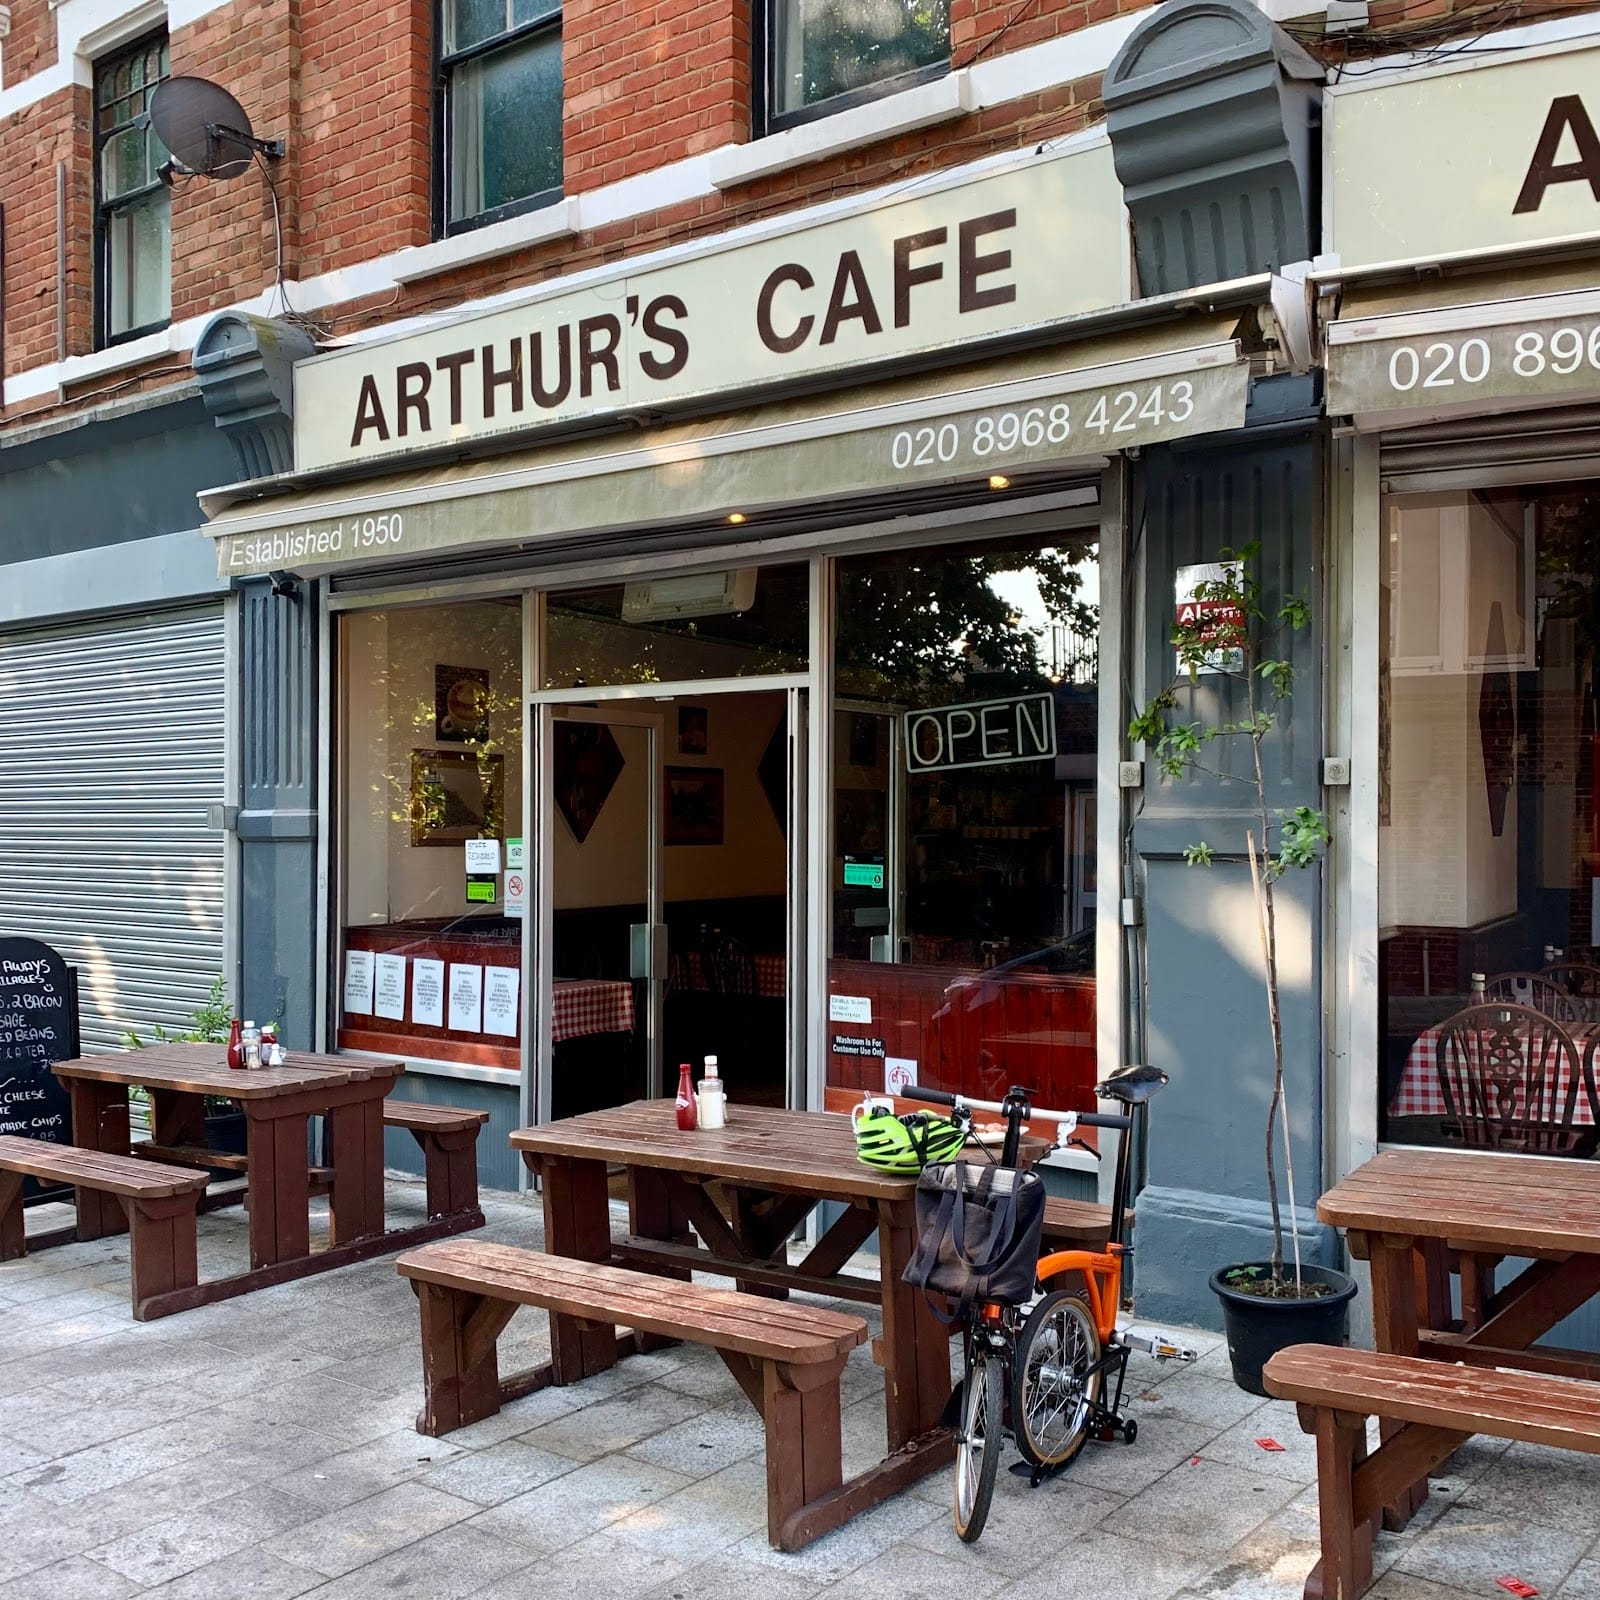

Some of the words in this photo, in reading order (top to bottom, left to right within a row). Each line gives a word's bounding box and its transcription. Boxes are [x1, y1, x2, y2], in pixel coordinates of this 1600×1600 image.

[1512, 94, 1600, 215] A
[350, 294, 690, 448] ARTHUR'S
[757, 208, 1017, 354] CAFE
[1388, 338, 1491, 391] 020
[891, 423, 960, 469] 020
[972, 403, 1070, 456] 8968
[1084, 380, 1195, 435] 4243
[229, 522, 343, 566] Established
[351, 513, 403, 548] 1950
[911, 700, 1049, 765] OPEN
[2, 959, 51, 975] AWAYS
[23, 994, 63, 1009] BACON
[832, 1044, 859, 1055] Customer
[860, 1046, 871, 1056] Use
[872, 1047, 885, 1058] Only
[835, 1036, 865, 1046] Washroom
[865, 1038, 871, 1047] Is
[872, 1039, 882, 1047] For
[4, 1089, 46, 1103] CHEESE
[31, 1114, 63, 1127] CHIPS
